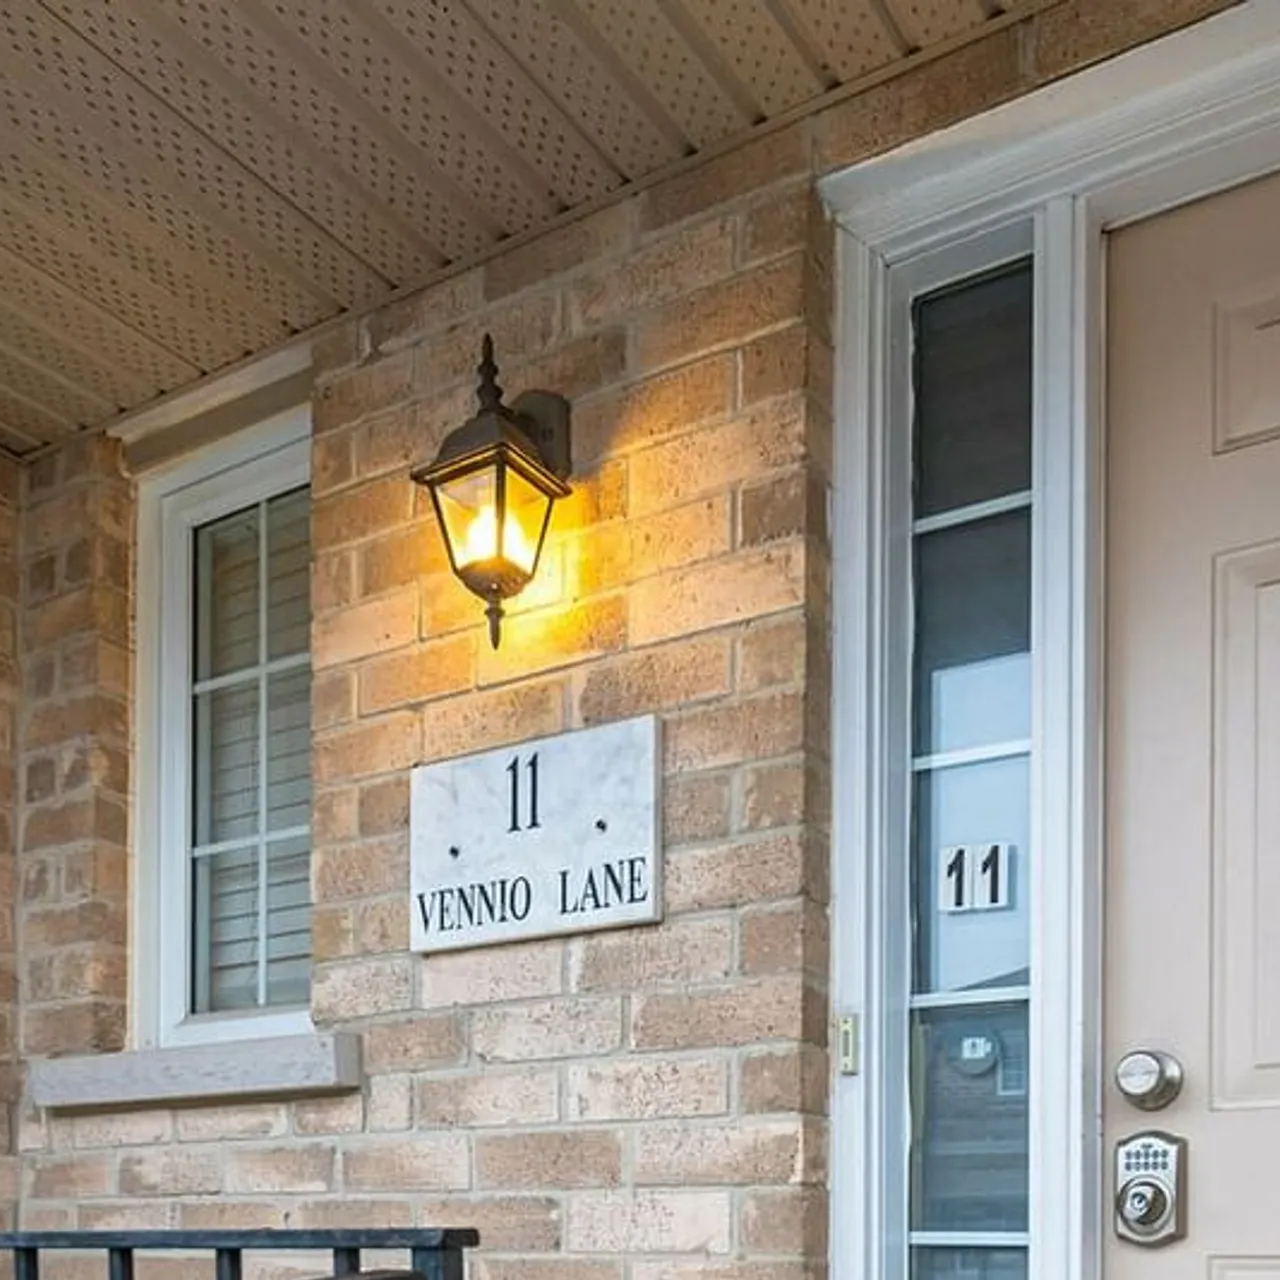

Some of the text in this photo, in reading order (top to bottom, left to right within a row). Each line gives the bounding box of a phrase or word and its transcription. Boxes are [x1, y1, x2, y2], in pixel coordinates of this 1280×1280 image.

[506, 752, 541, 833] 11
[417, 857, 648, 935] VENNIO LANE
[946, 844, 1000, 907] 11
